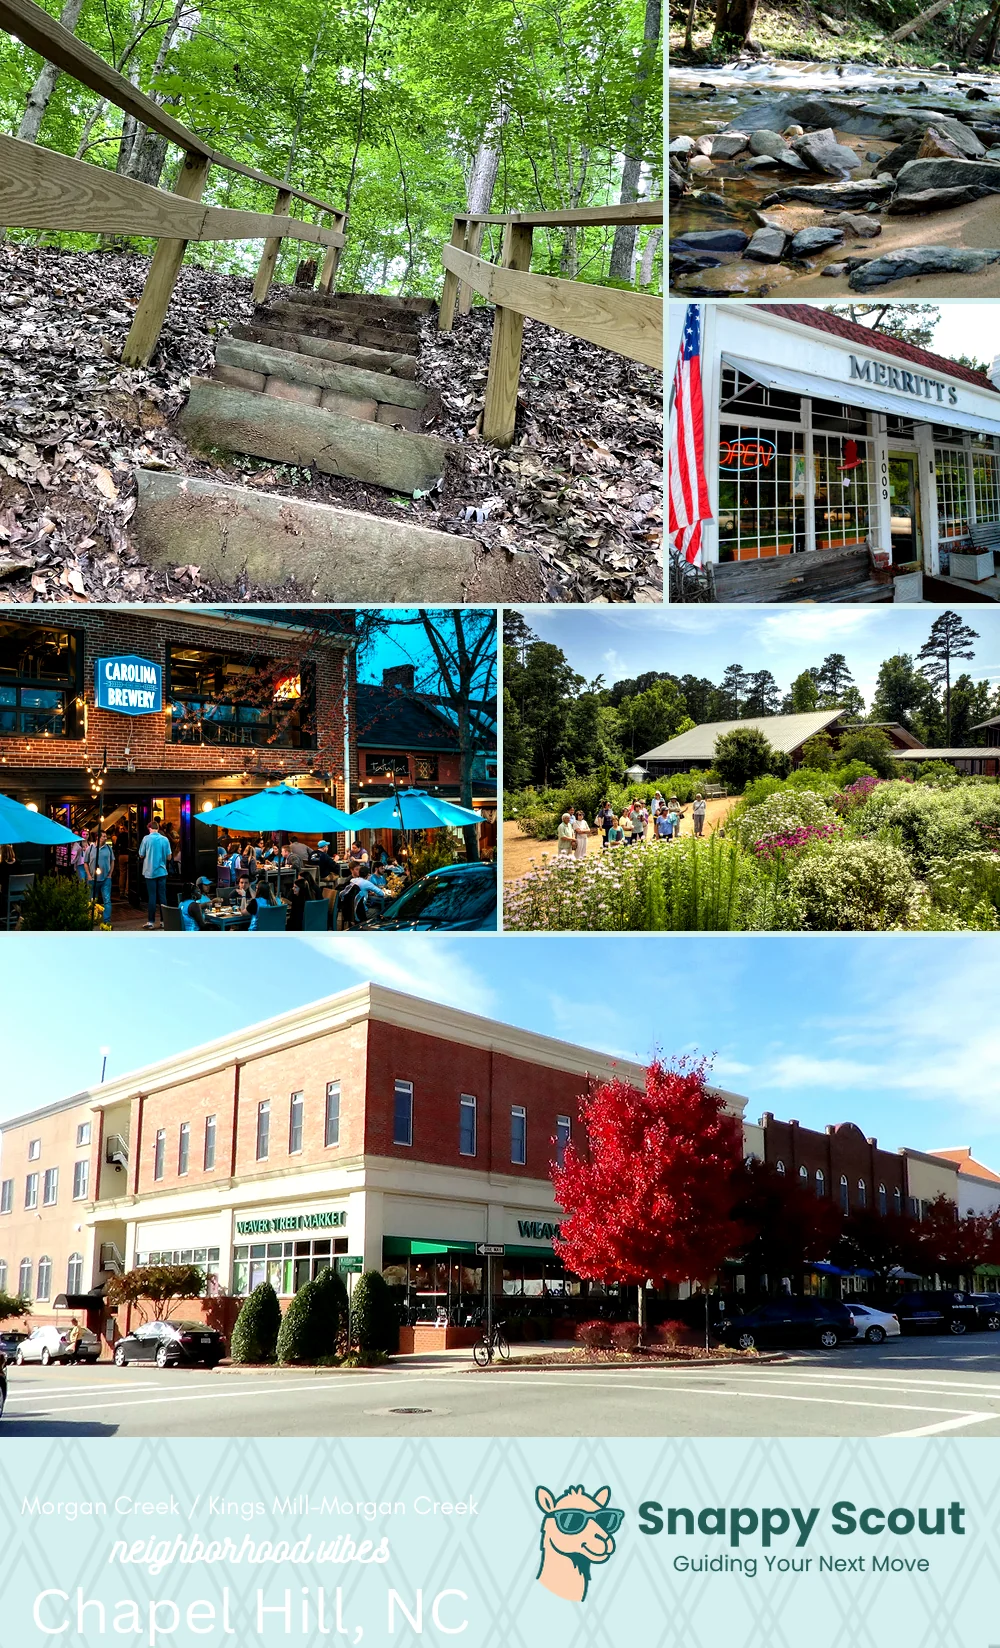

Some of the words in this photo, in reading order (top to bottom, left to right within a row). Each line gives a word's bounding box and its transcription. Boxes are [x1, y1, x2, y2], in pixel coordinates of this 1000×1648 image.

[718, 441, 773, 467] OPEN
[105, 661, 157, 685] CAROLINA
[107, 687, 156, 709] BREWERY
[236, 1218, 272, 1235] WEAVER
[270, 1214, 304, 1233] STREET
[303, 1210, 348, 1229] MARKET
